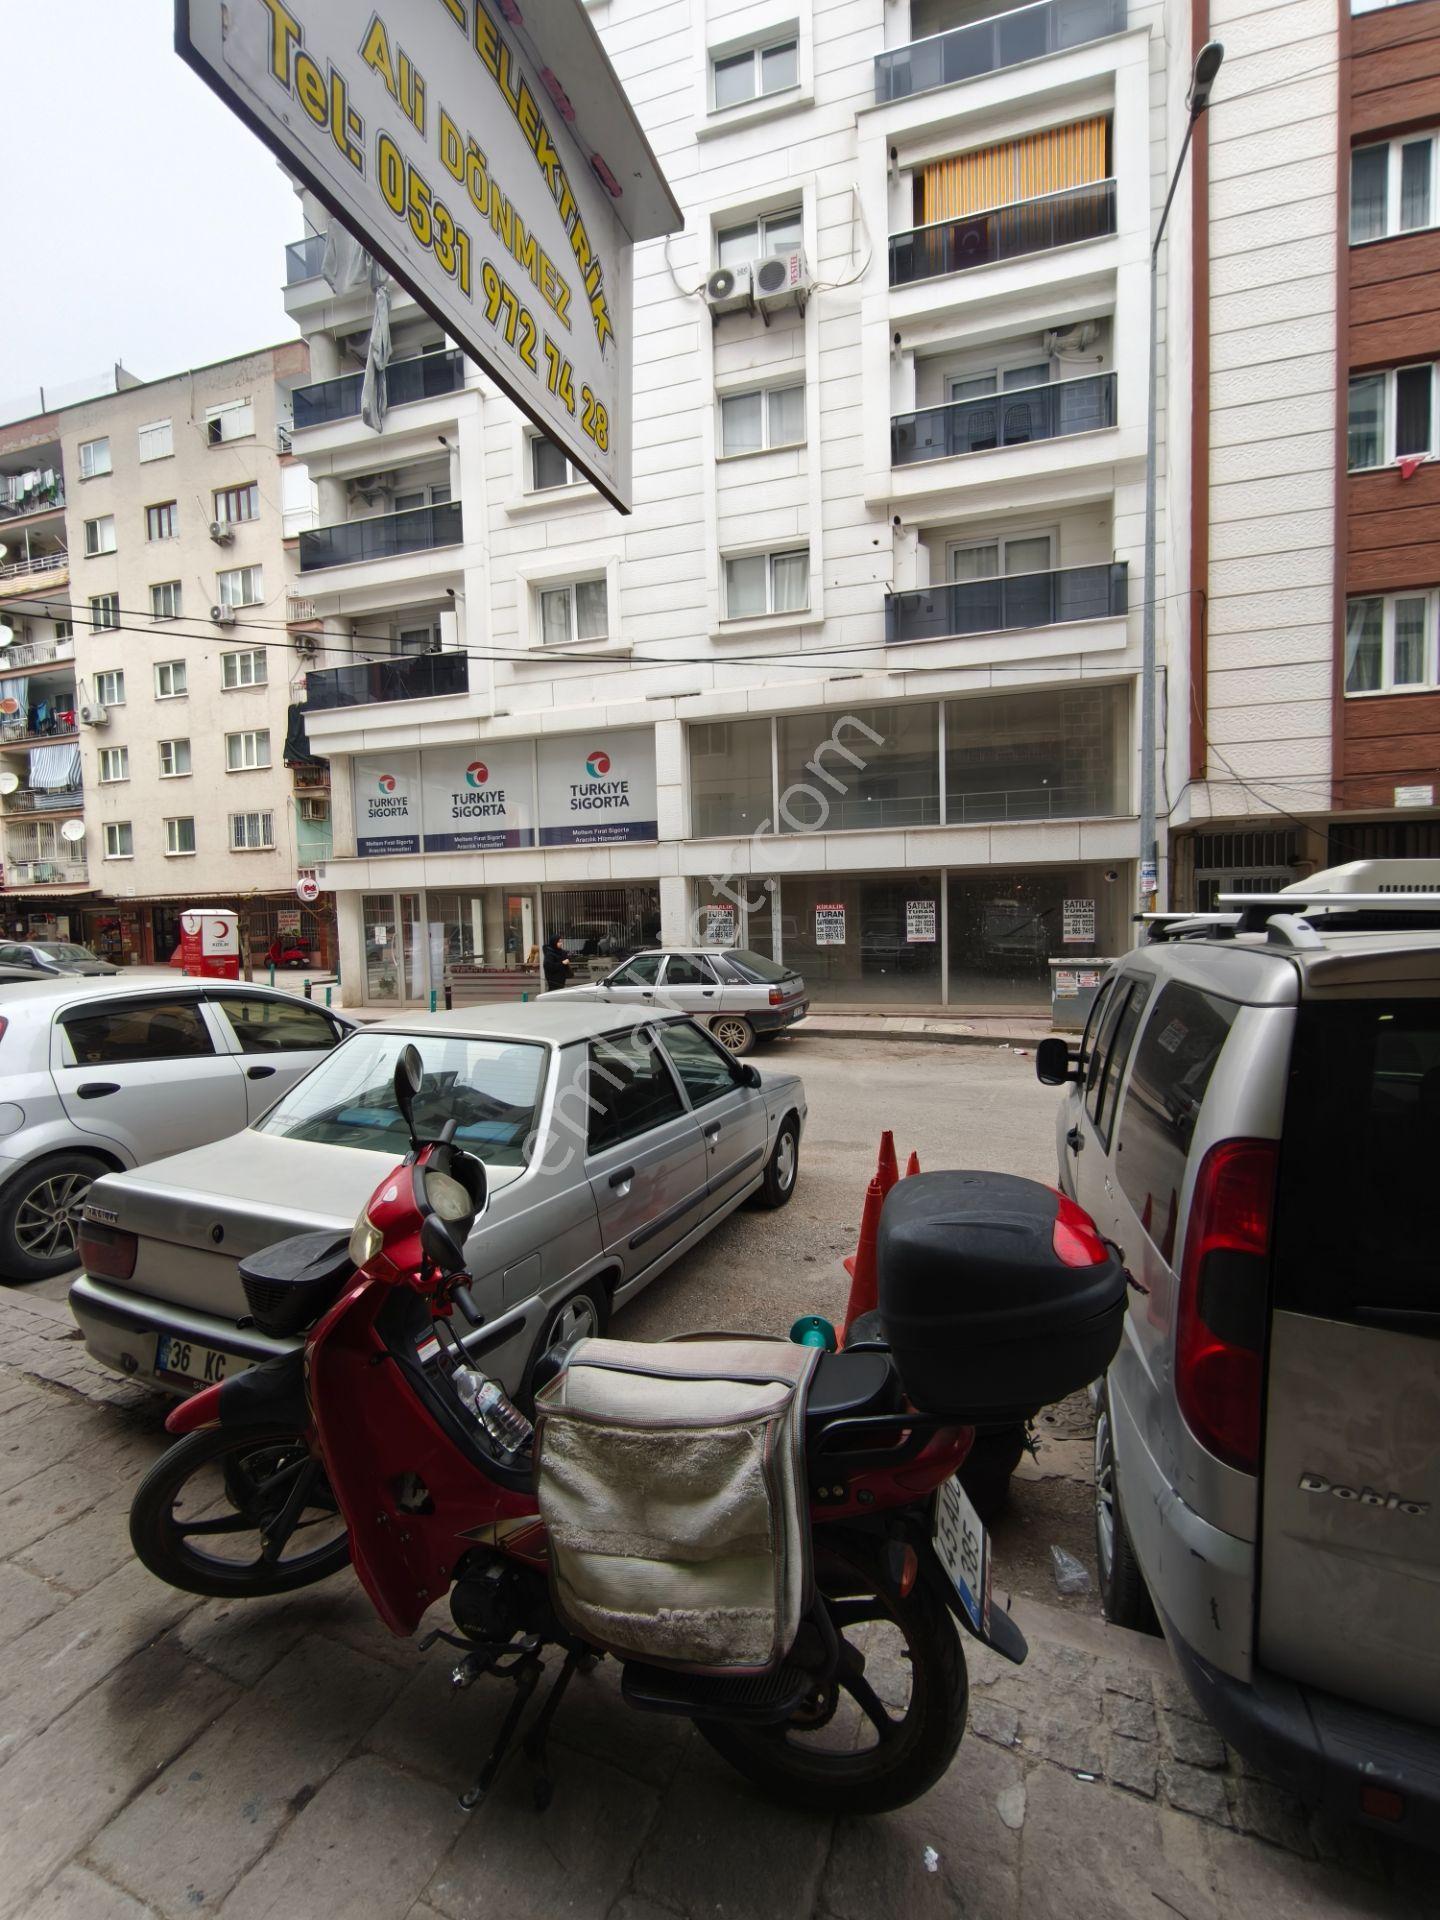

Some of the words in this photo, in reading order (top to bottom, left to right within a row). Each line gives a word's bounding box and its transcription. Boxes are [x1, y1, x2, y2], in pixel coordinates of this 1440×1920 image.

[474, 0, 613, 350] ELEKTRİK
[439, 107, 571, 331] DÖNMEZ
[378, 132, 471, 298] 0531
[482, 261, 538, 374] 972
[544, 334, 575, 415] 74
[581, 384, 609, 452] 28
[570, 780, 629, 796] TÜRKİYE
[451, 789, 506, 805] TÜRKİYE
[570, 795, 630, 810] SİGORTA
[368, 806, 409, 818] SİGORTA
[451, 803, 506, 818] SİGORTA
[907, 902, 934, 910] SATILIK
[1064, 900, 1094, 908] SATILIK
[816, 910, 844, 918] TURAN
[170, 1341, 192, 1372] 36
[204, 1350, 227, 1382] KC
[940, 1516, 958, 1569] 45
[960, 1519, 979, 1590] 385
